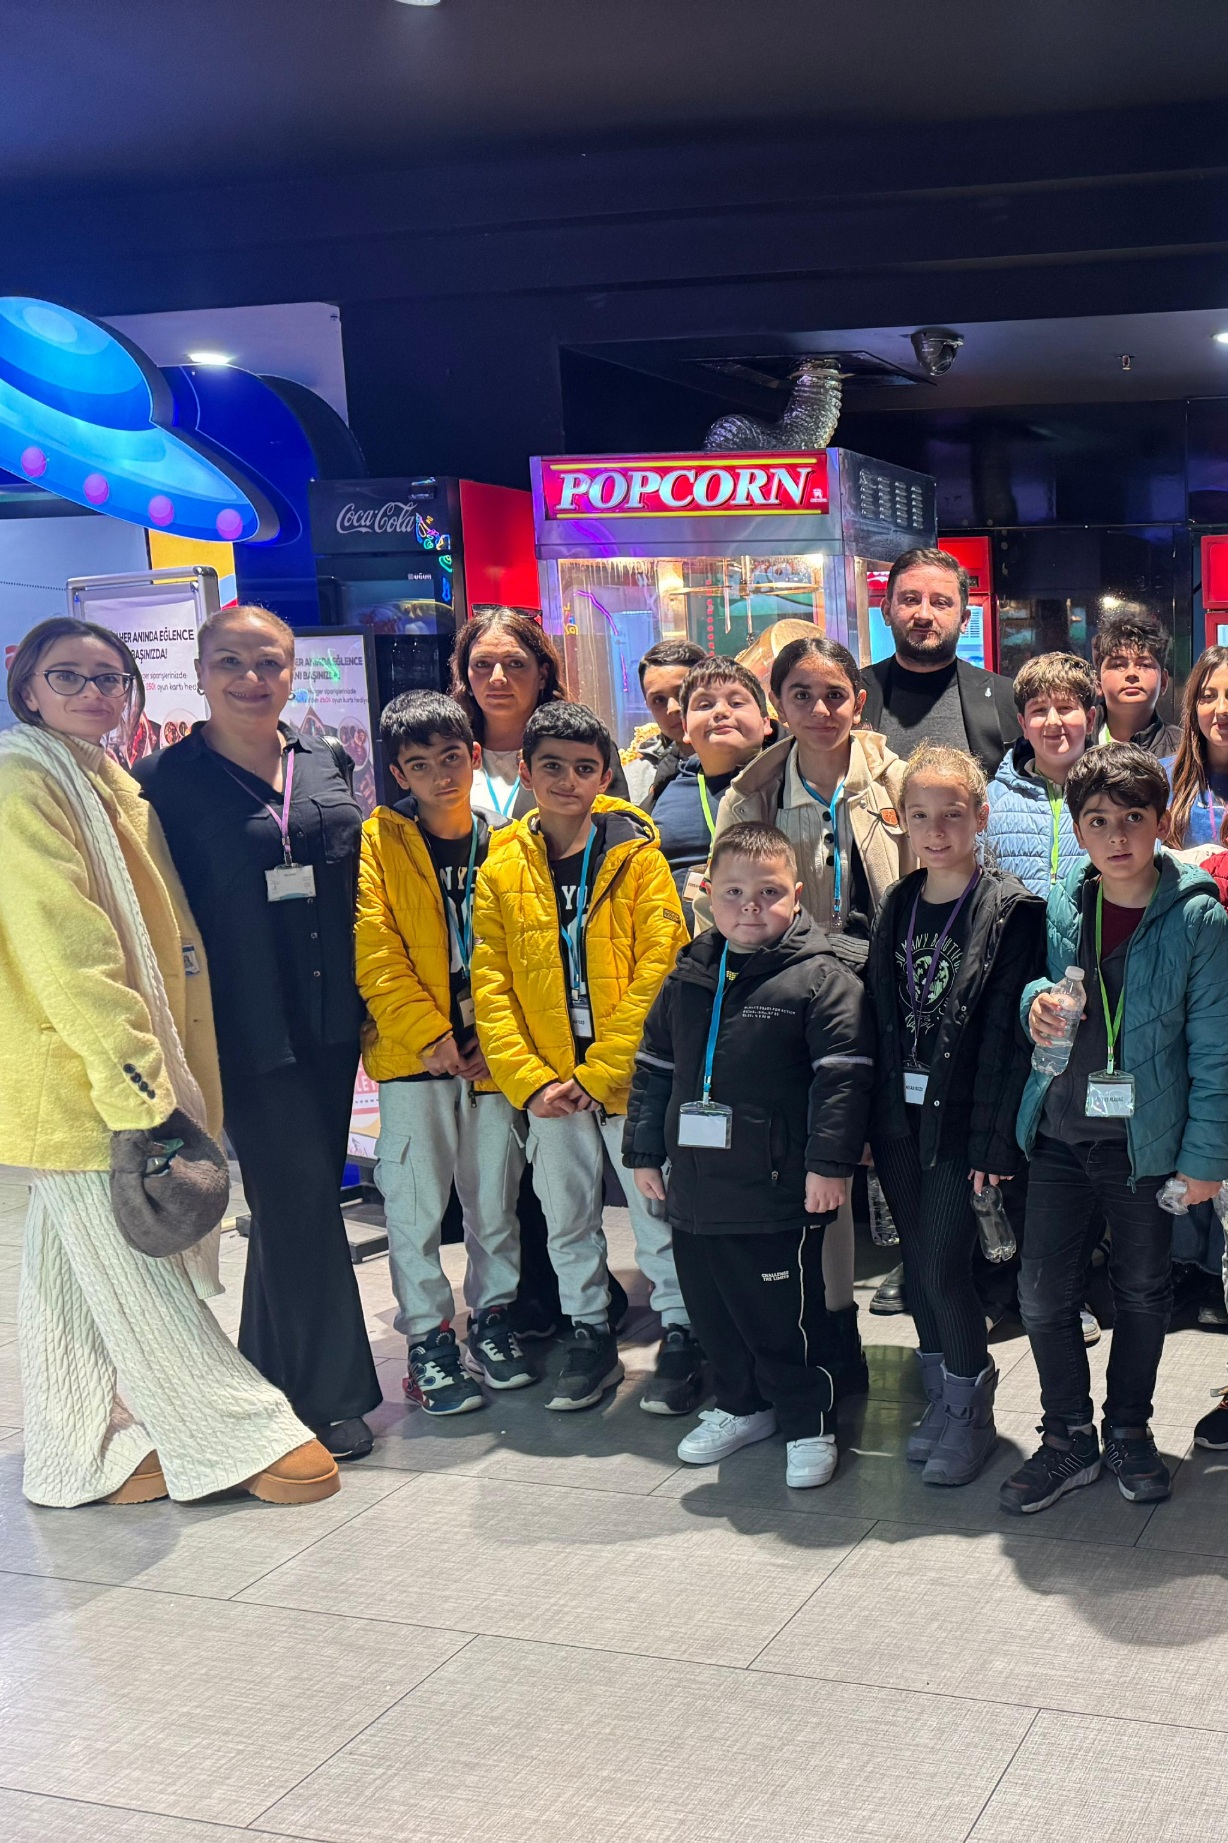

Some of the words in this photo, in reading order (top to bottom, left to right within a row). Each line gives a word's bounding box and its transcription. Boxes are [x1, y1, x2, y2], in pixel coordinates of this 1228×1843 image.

[556, 467, 813, 511] POPCORN
[336, 501, 418, 534] Coca-Cola
[159, 626, 195, 642] EĞLENCE
